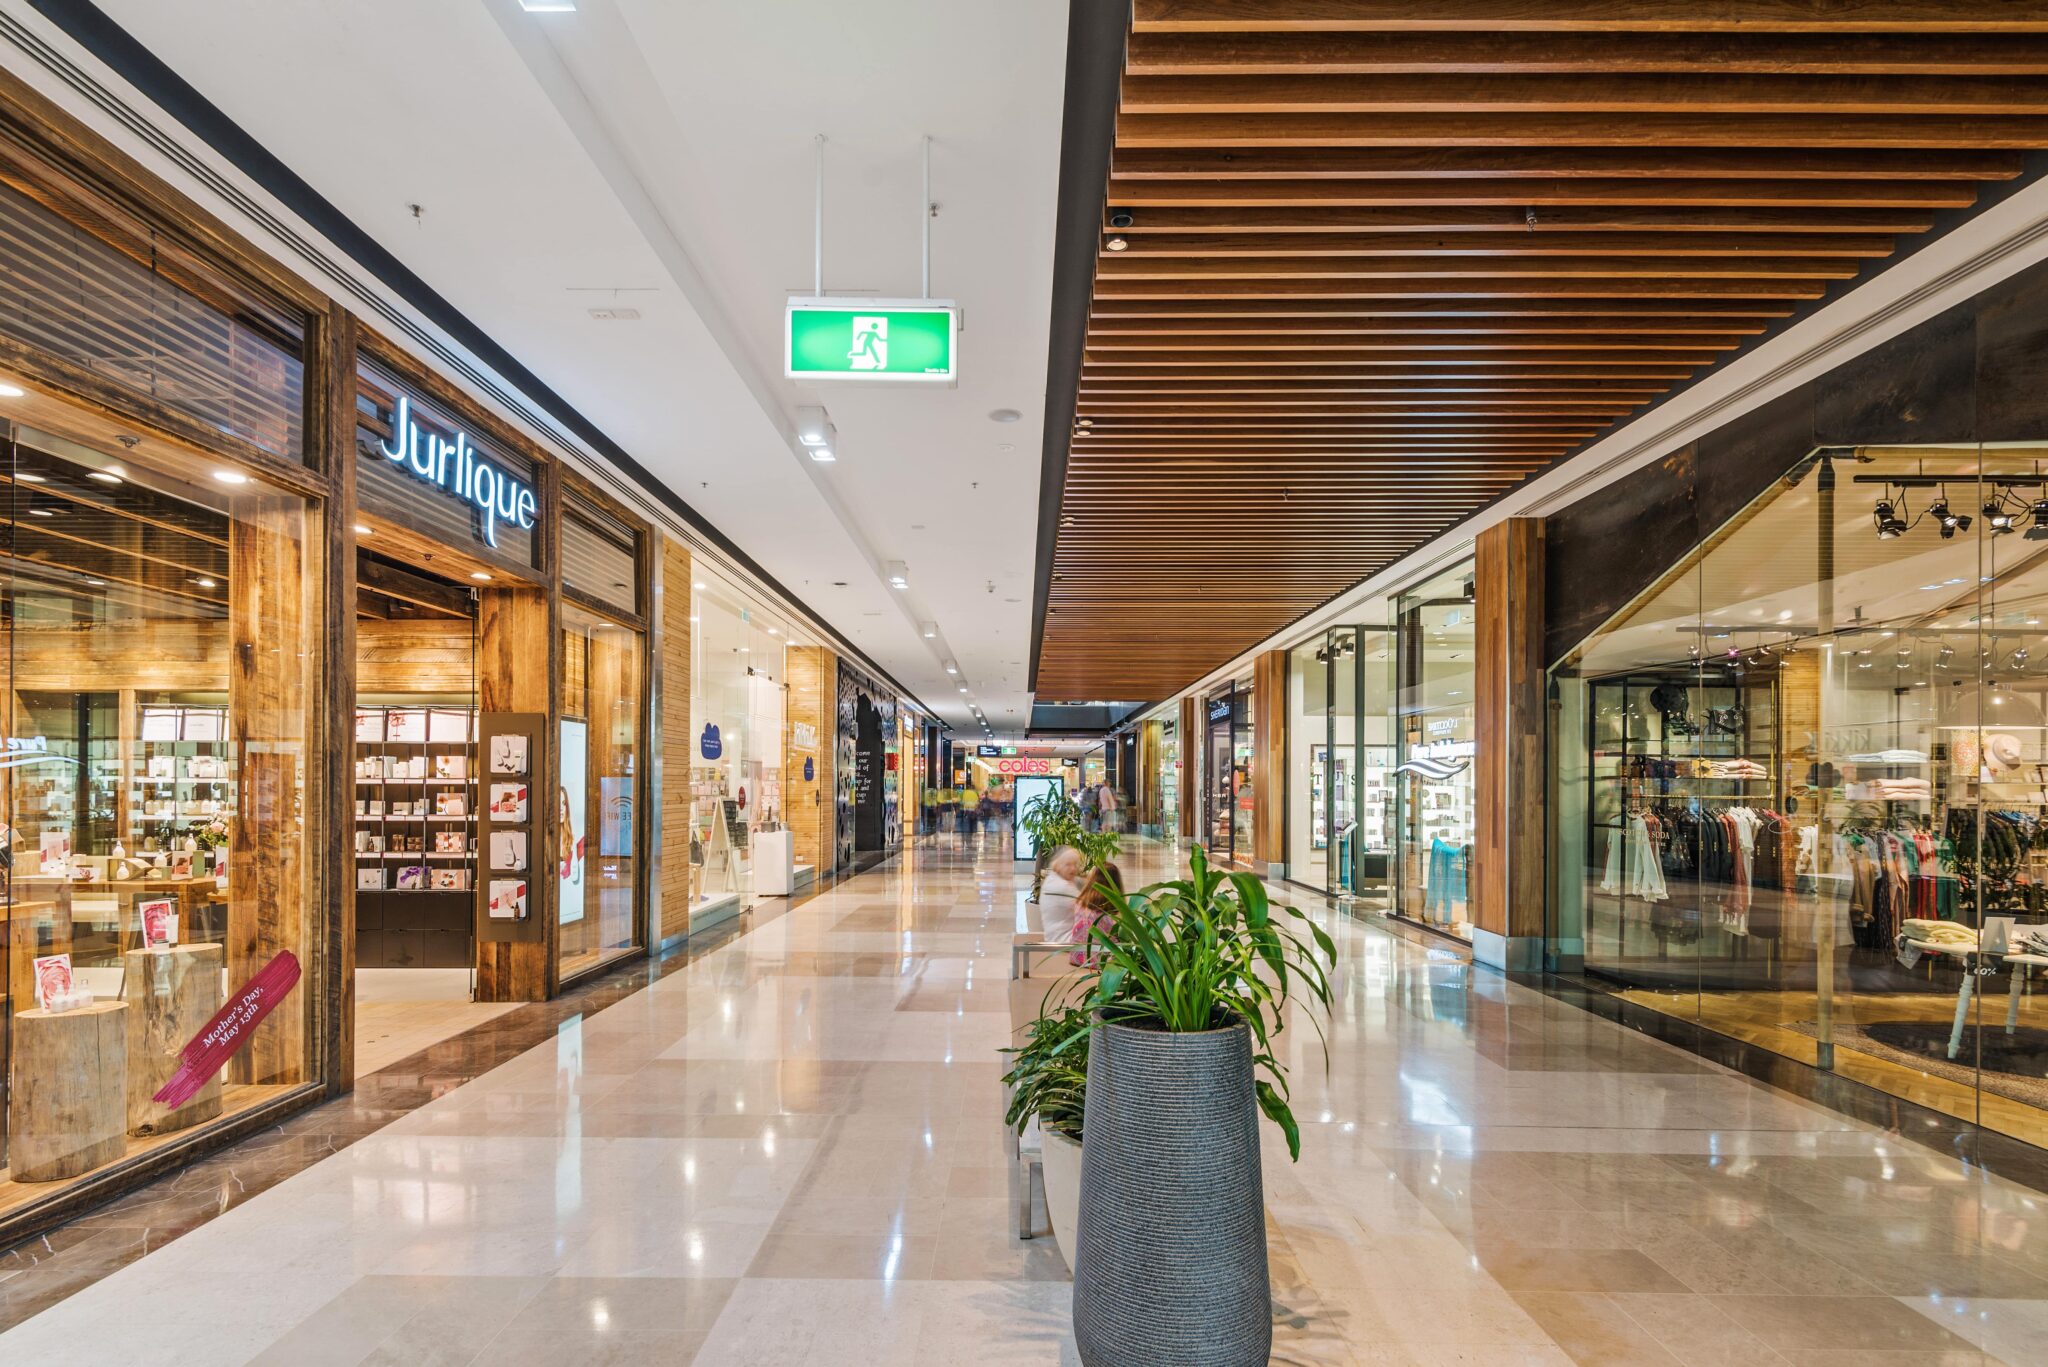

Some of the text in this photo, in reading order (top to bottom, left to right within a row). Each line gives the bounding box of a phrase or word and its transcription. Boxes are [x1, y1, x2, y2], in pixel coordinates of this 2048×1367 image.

[381, 397, 535, 549] Jurlique
[999, 755, 1049, 773] coles
[203, 1005, 243, 1049] Mother's
[218, 1003, 259, 1047] May 13th
